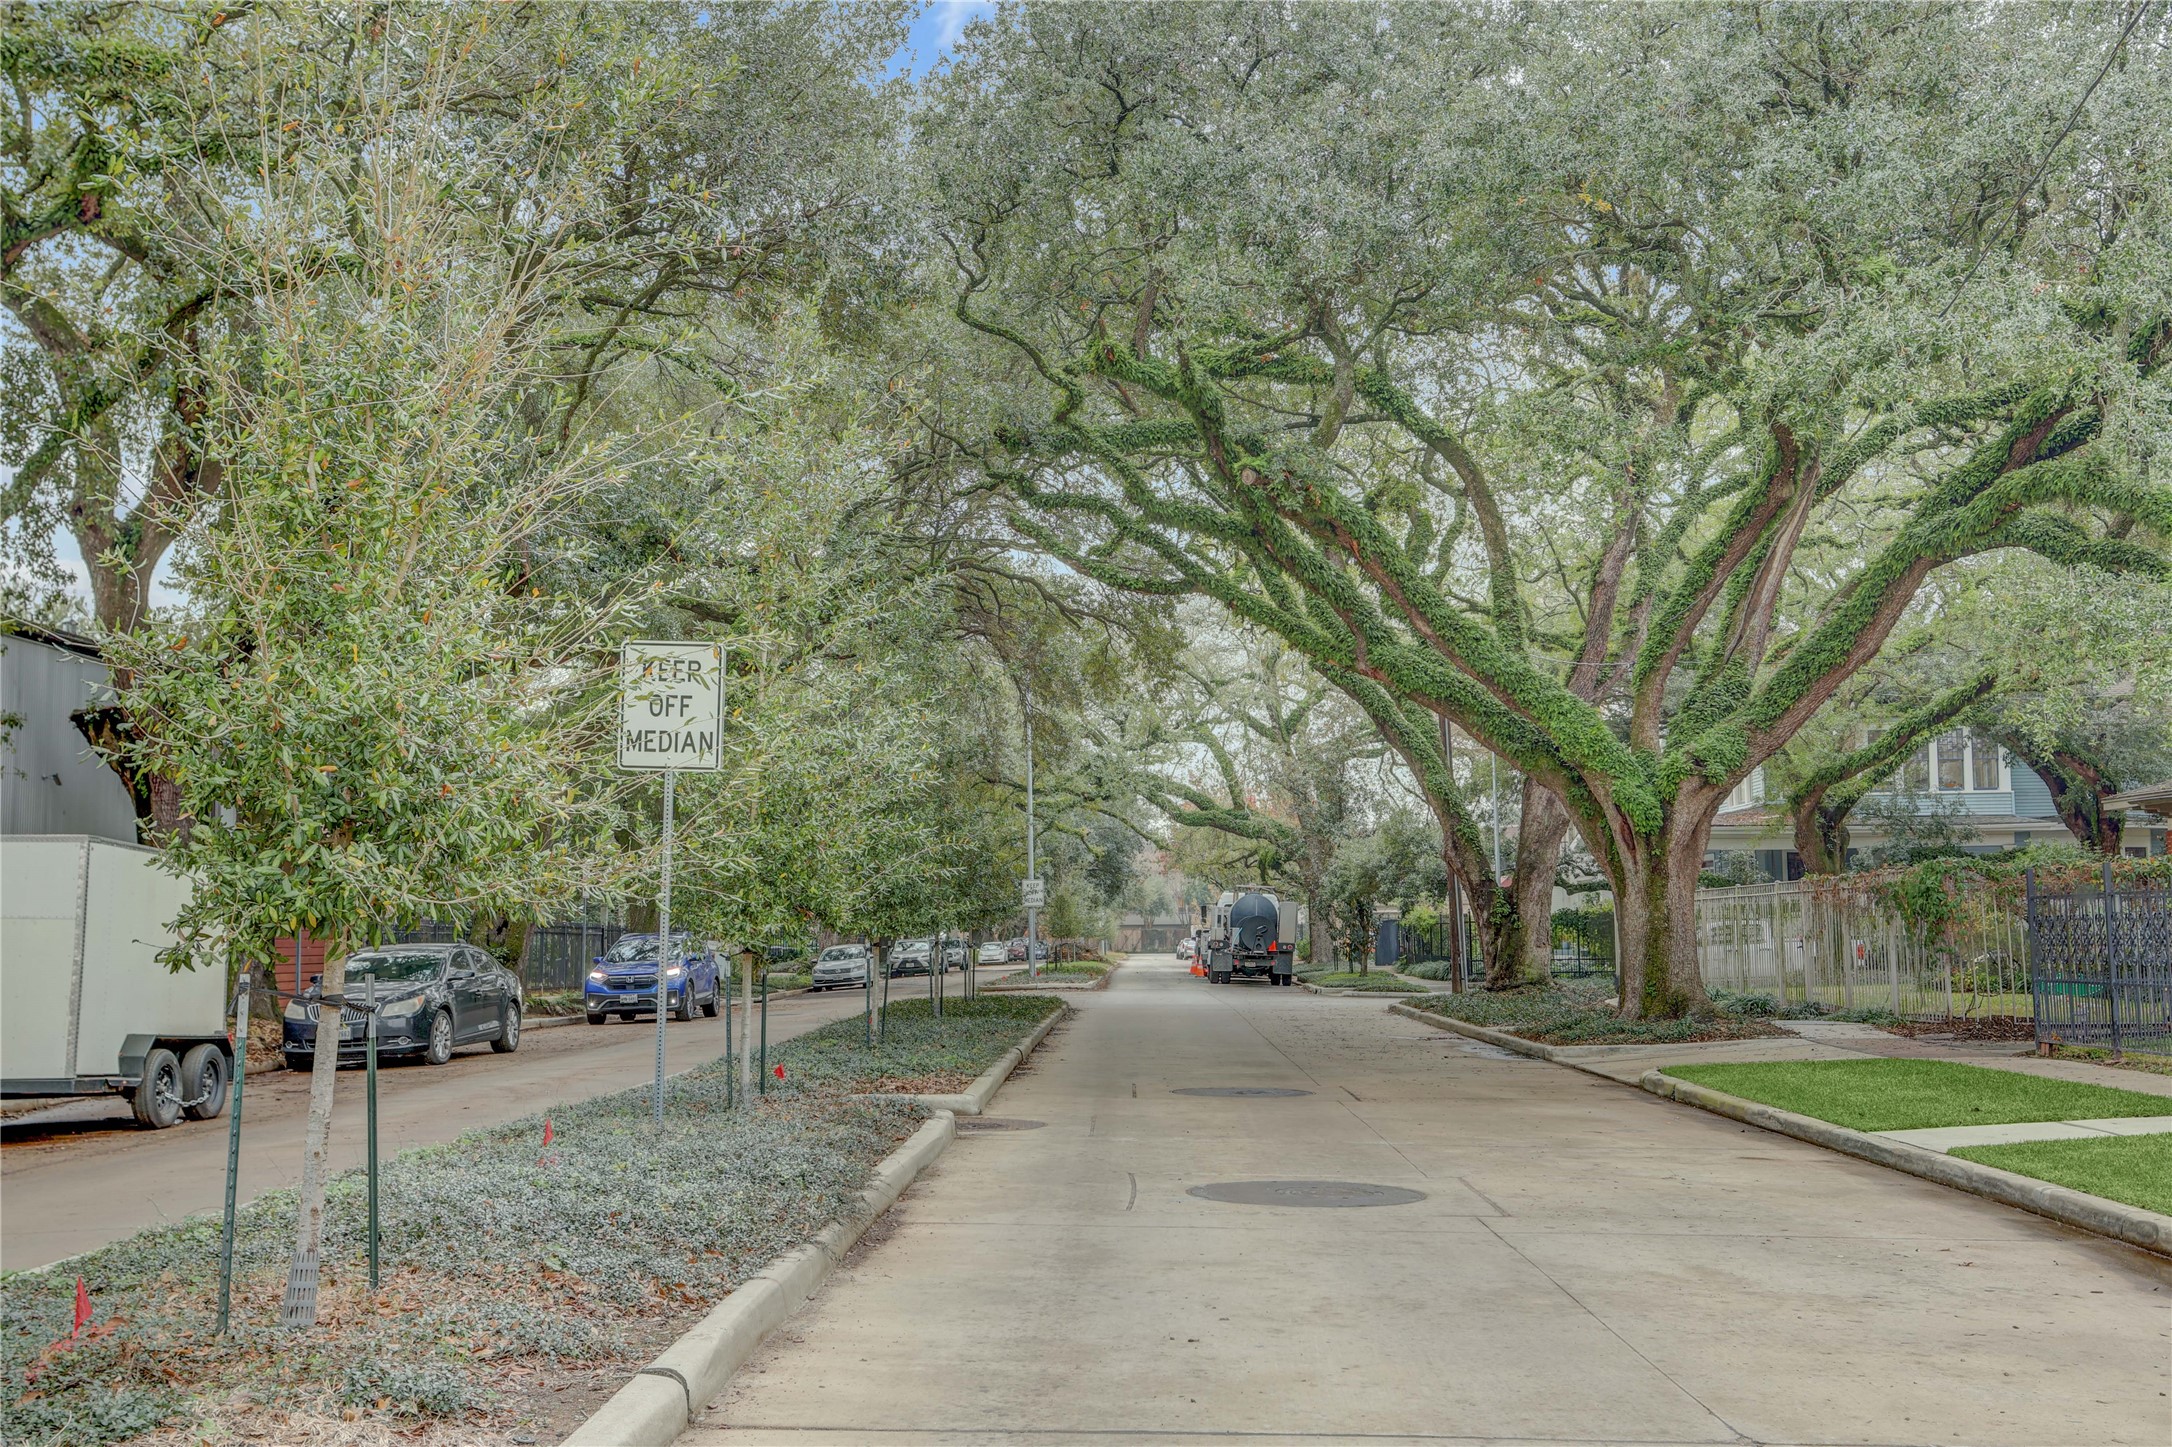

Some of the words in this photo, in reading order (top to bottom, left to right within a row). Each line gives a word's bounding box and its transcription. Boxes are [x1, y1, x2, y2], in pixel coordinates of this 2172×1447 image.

[642, 660, 702, 682] KEEP
[650, 694, 693, 717] OFF
[626, 730, 714, 753] MEDIAN
